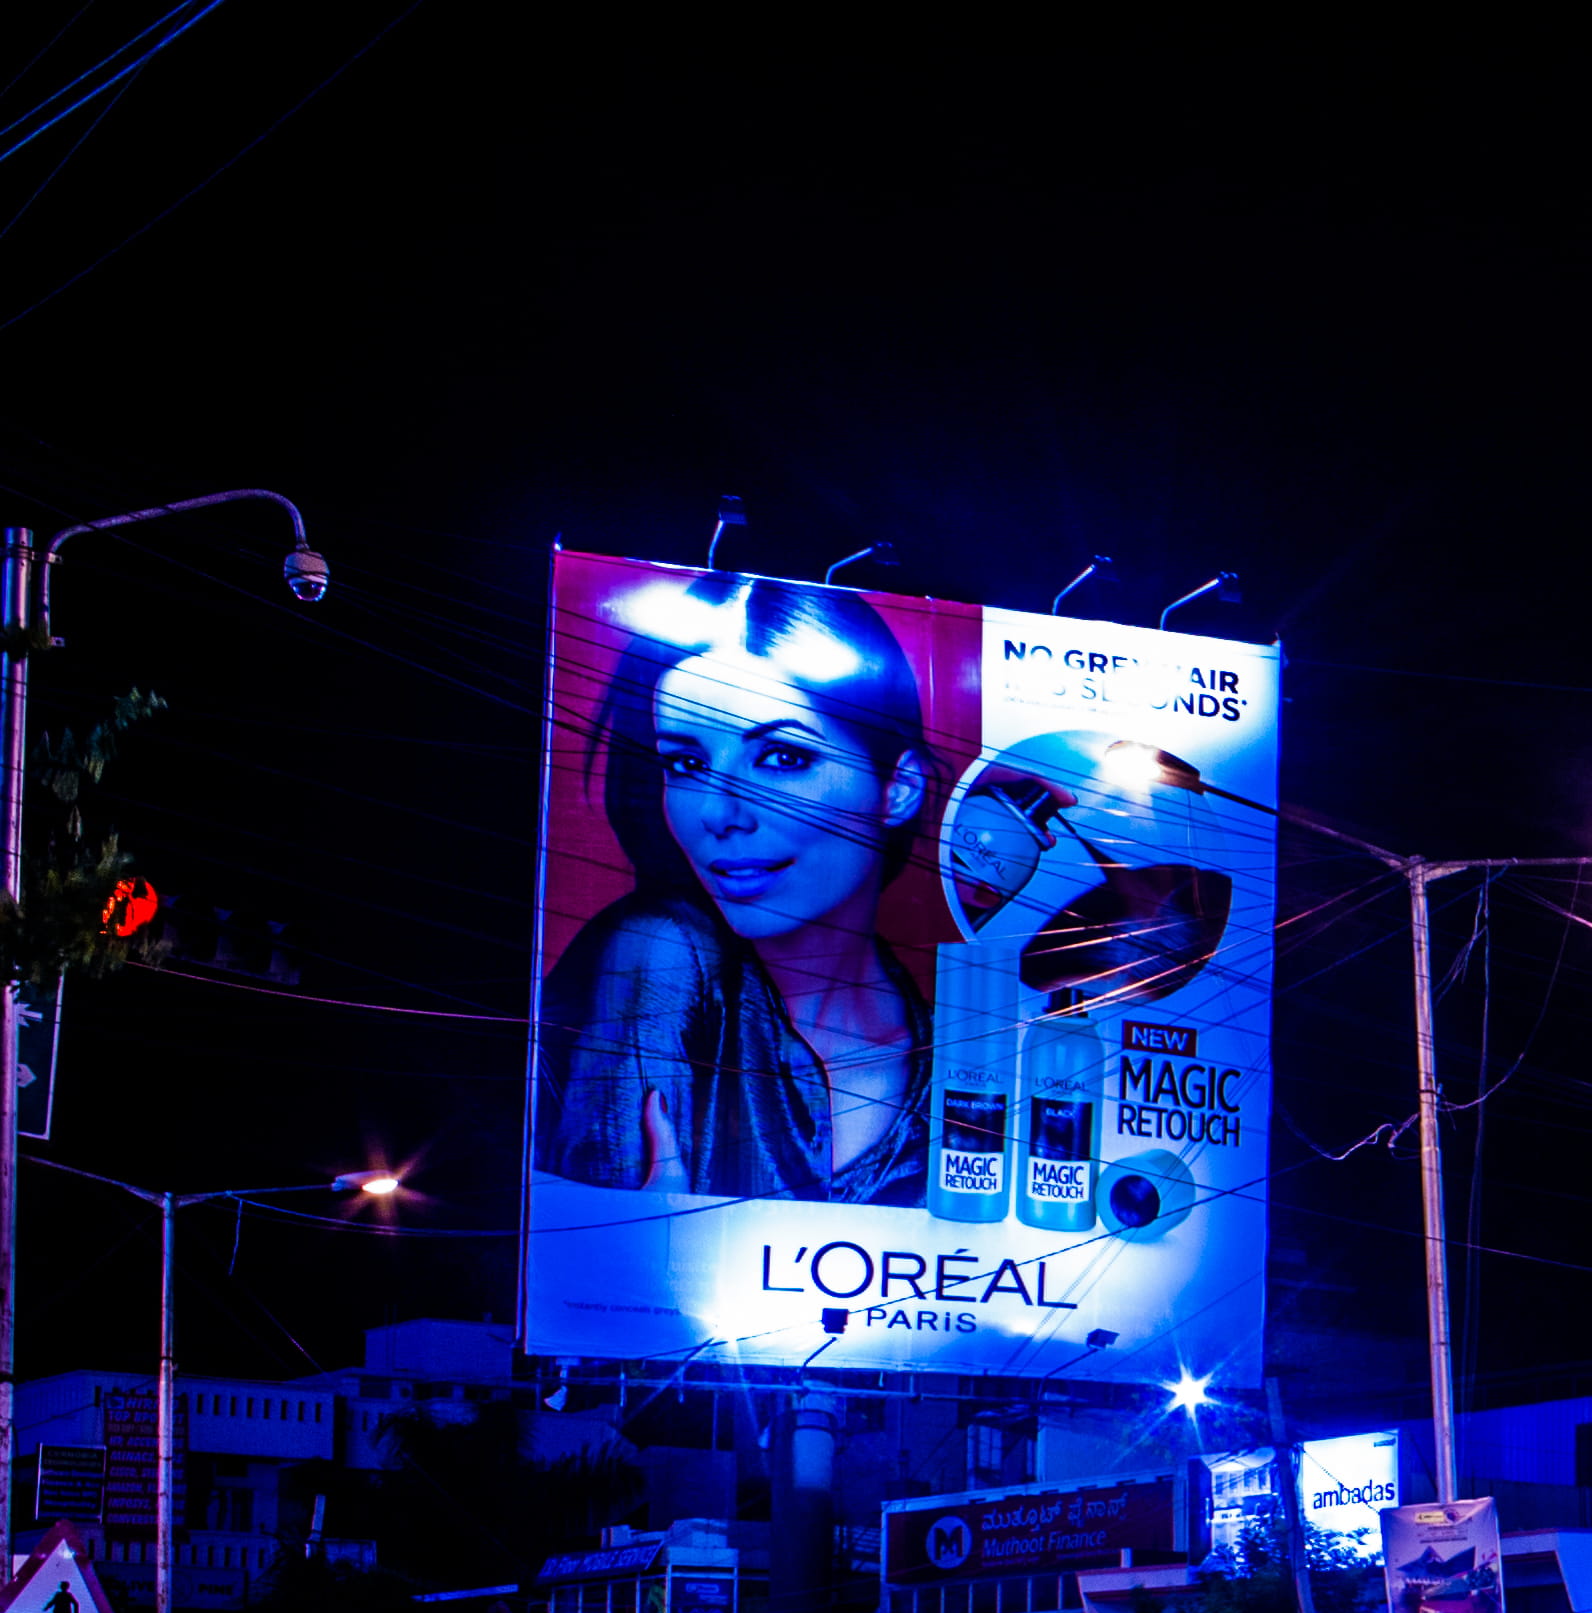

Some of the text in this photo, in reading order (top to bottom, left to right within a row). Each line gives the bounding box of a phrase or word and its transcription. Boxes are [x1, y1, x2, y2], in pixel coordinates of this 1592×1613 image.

[1190, 667, 1240, 695] AIR
[1130, 1026, 1189, 1051] NEW
[1119, 1055, 1242, 1114] MAGIC
[1117, 1103, 1241, 1148] RETOUCH
[945, 1154, 998, 1177] MAGIC
[1032, 1162, 1084, 1186] MAGIC
[945, 1174, 998, 1191] RETOUCH
[1031, 1183, 1084, 1200] RETOUCH
[761, 1240, 1078, 1310] L'ORÉAL
[1312, 1480, 1396, 1512] ambadas
[983, 1537, 1044, 1558] Muthoot
[1048, 1530, 1107, 1551] Finance
